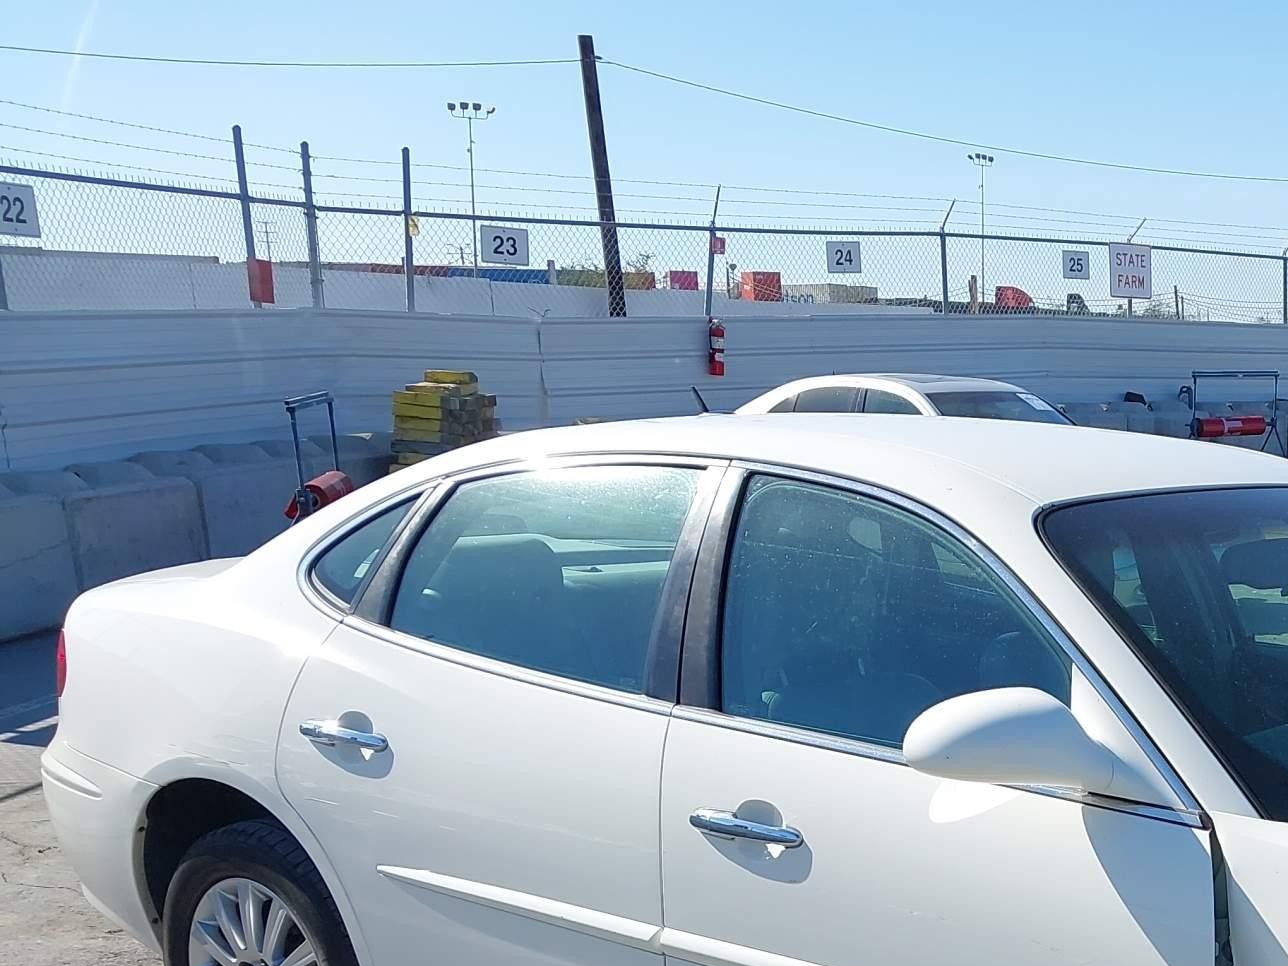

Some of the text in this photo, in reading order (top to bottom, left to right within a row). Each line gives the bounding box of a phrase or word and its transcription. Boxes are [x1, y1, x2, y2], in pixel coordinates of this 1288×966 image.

[0, 195, 27, 224] 22
[492, 235, 517, 256] 23
[835, 249, 853, 266] 24
[1069, 257, 1084, 273] 25
[1116, 252, 1146, 269] STATE
[1117, 274, 1145, 290] FARM
